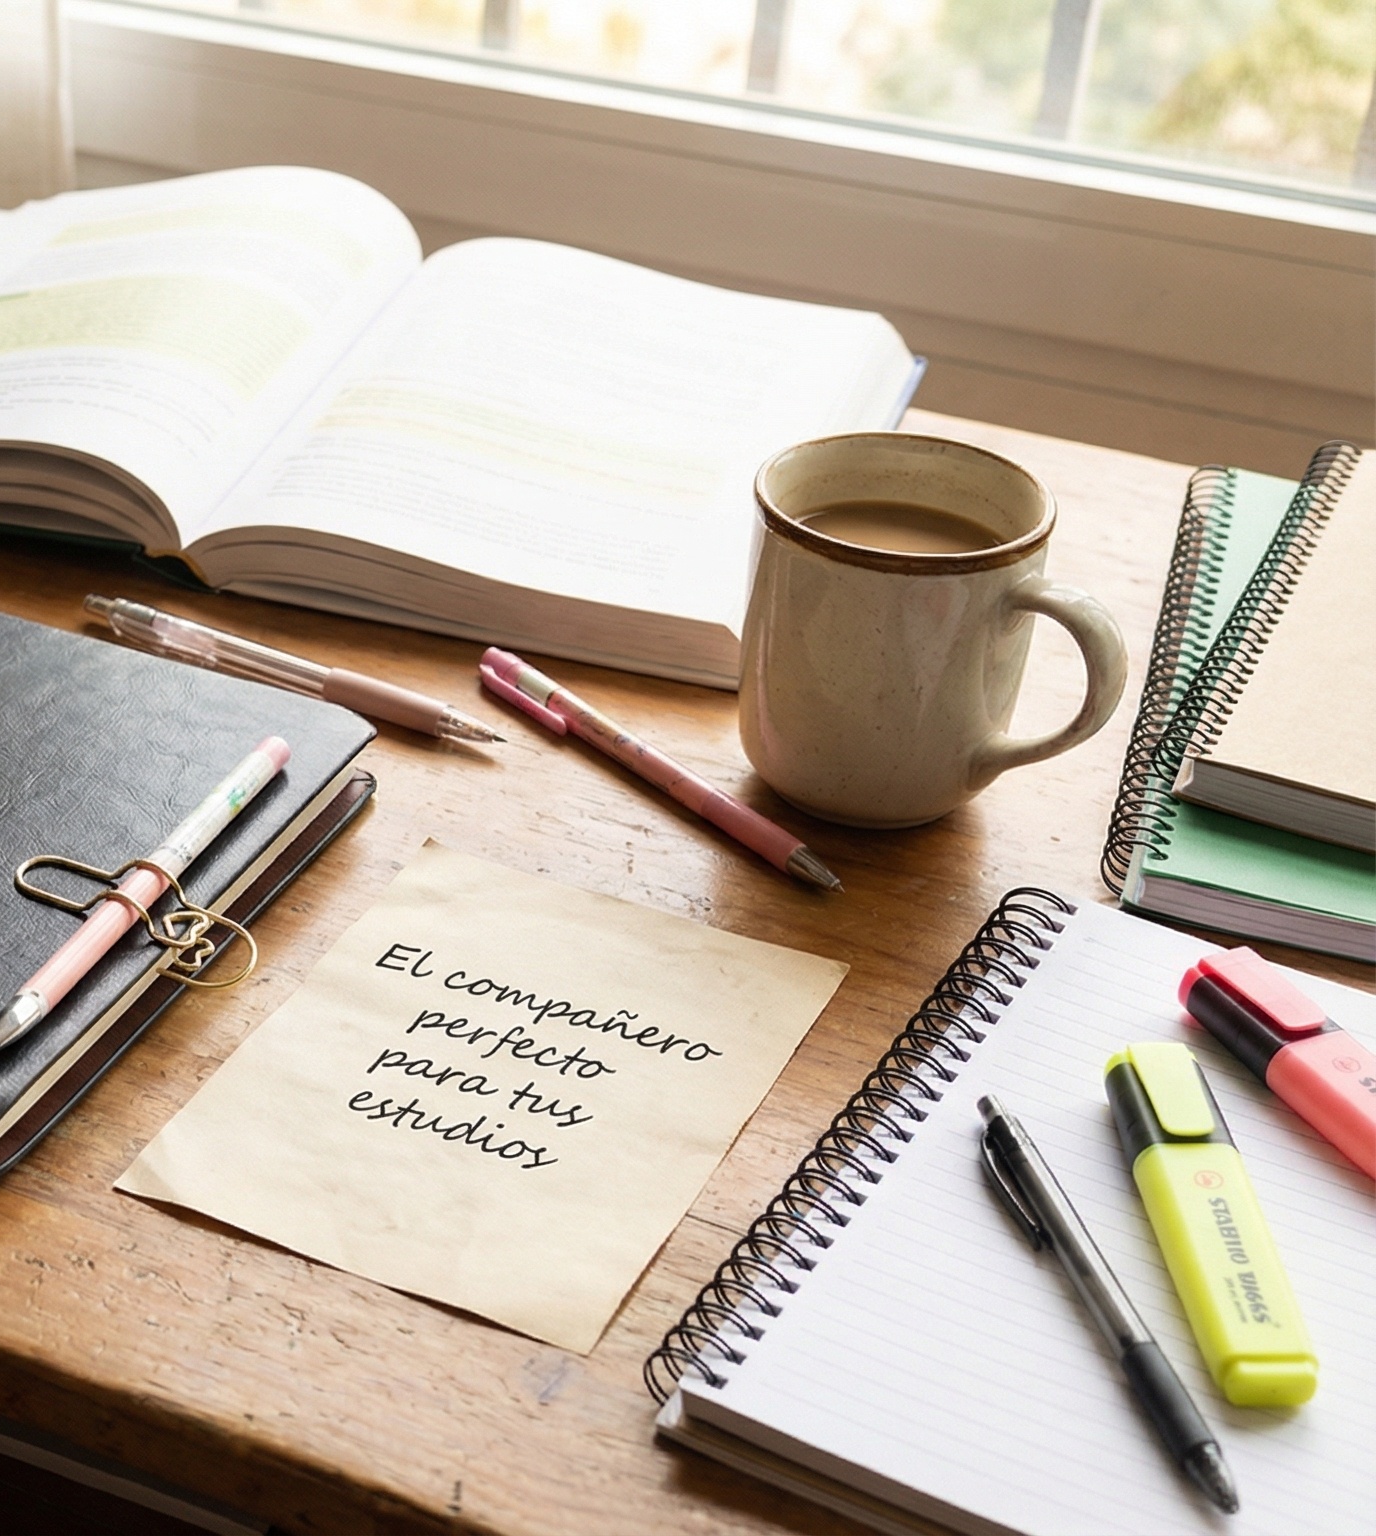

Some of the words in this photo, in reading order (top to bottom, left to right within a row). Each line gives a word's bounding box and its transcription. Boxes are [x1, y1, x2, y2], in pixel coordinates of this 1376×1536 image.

[375, 943, 433, 978] El
[444, 970, 723, 1061] compañero
[405, 1010, 616, 1079] perfecto
[366, 1048, 499, 1096] para
[508, 1081, 593, 1128] tus
[348, 1091, 558, 1169] estudios
